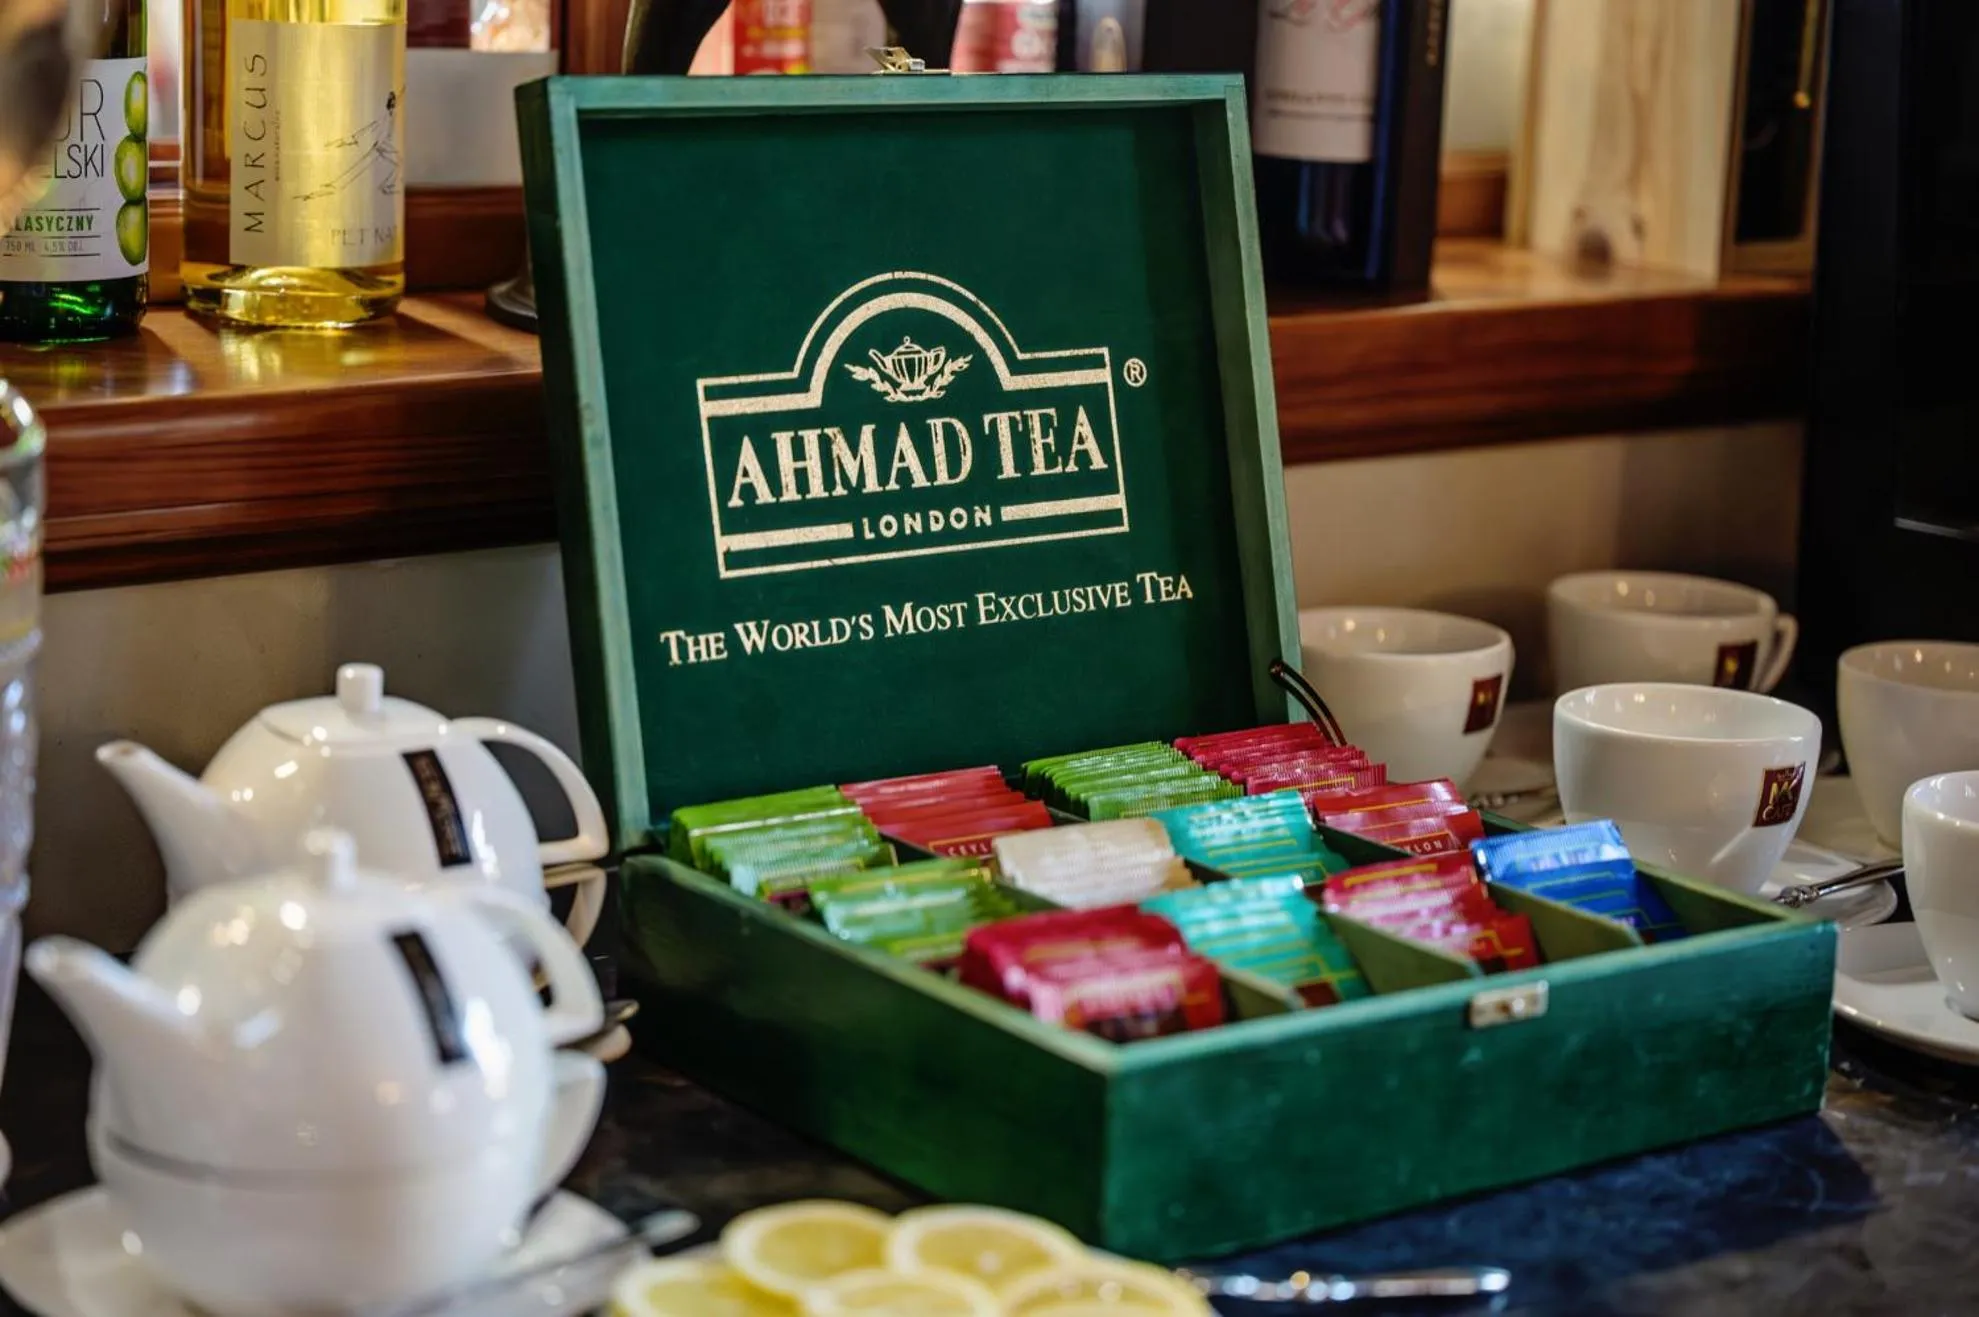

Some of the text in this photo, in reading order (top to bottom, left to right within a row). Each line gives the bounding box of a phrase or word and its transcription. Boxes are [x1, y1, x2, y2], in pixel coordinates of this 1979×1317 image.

[50, 143, 105, 179] LSKI
[243, 54, 268, 234] MARCUS
[12, 213, 95, 233] LASYCZNY
[728, 405, 1109, 508] AHMAD TEA
[862, 504, 993, 540] LONDON
[660, 571, 1193, 666] THE WORLD'S MOST EXCLUSIVE TEA
